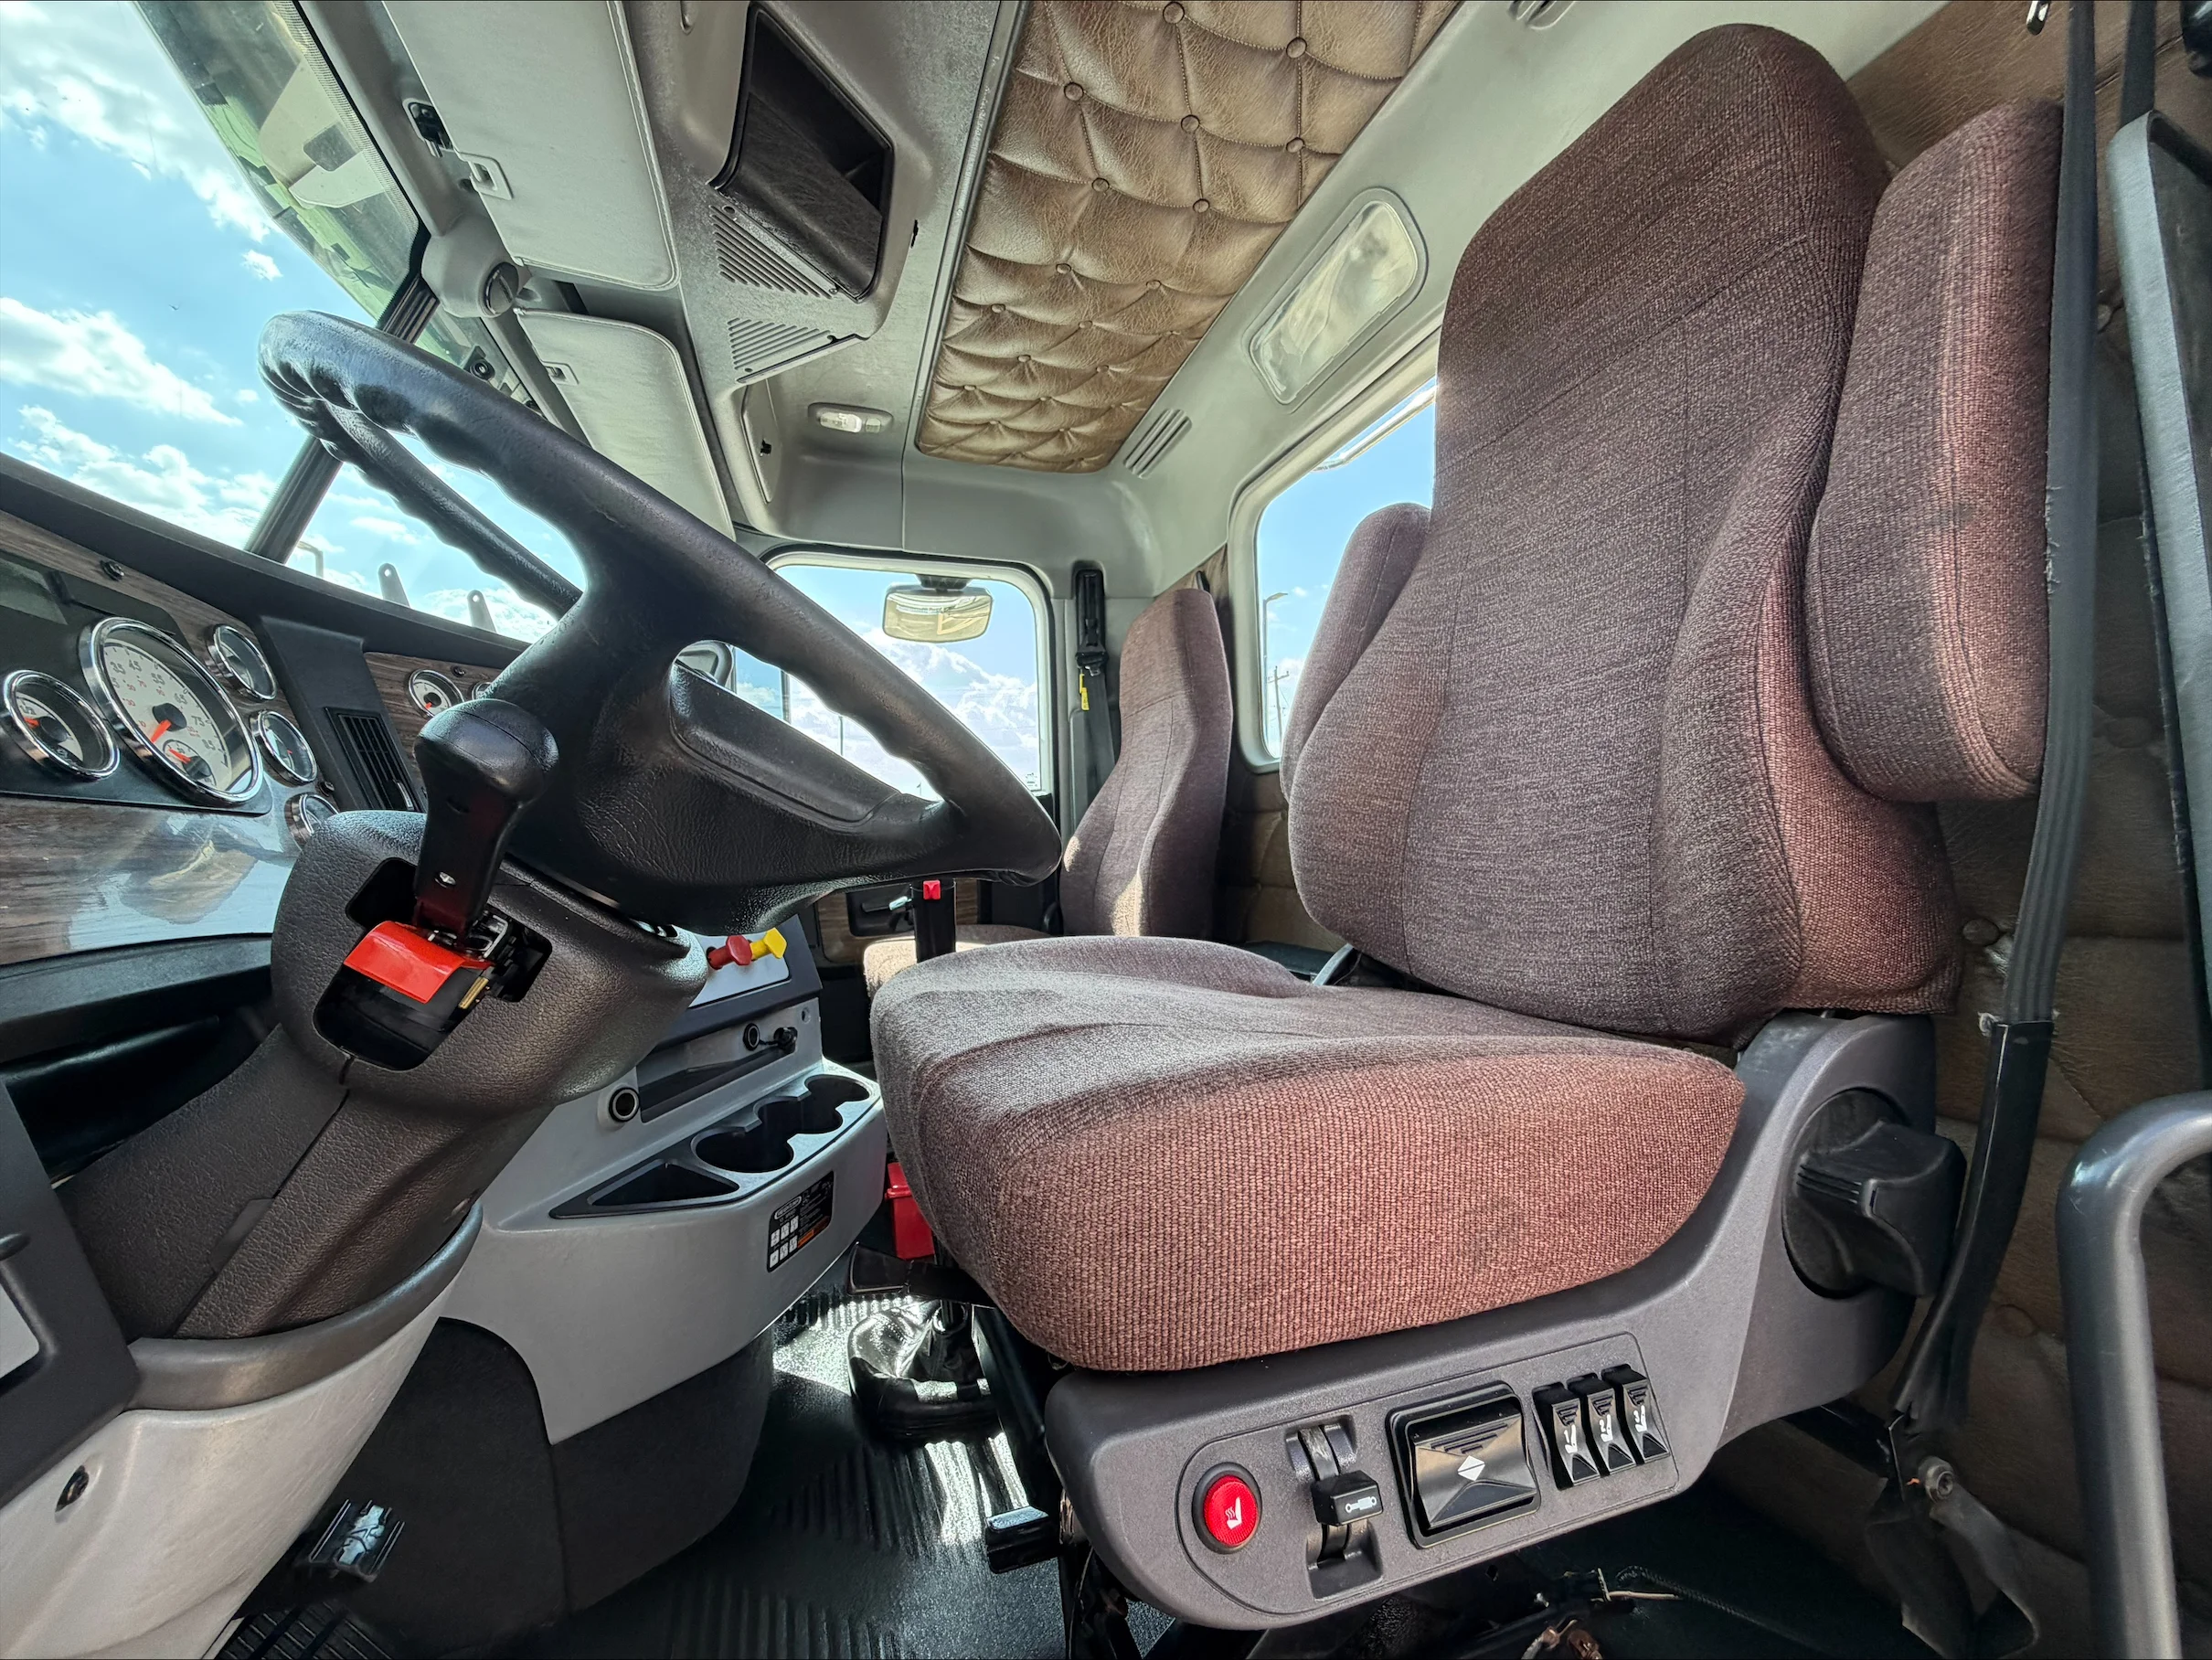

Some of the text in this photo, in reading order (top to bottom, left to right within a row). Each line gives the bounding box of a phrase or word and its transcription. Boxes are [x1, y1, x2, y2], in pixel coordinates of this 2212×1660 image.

[110, 661, 126, 675] 35
[129, 659, 143, 672] 45
[190, 715, 206, 727] 75
[1633, 1410, 1641, 1423] 3
[1599, 1419, 1606, 1432] 2
[1564, 1430, 1570, 1443] 1
